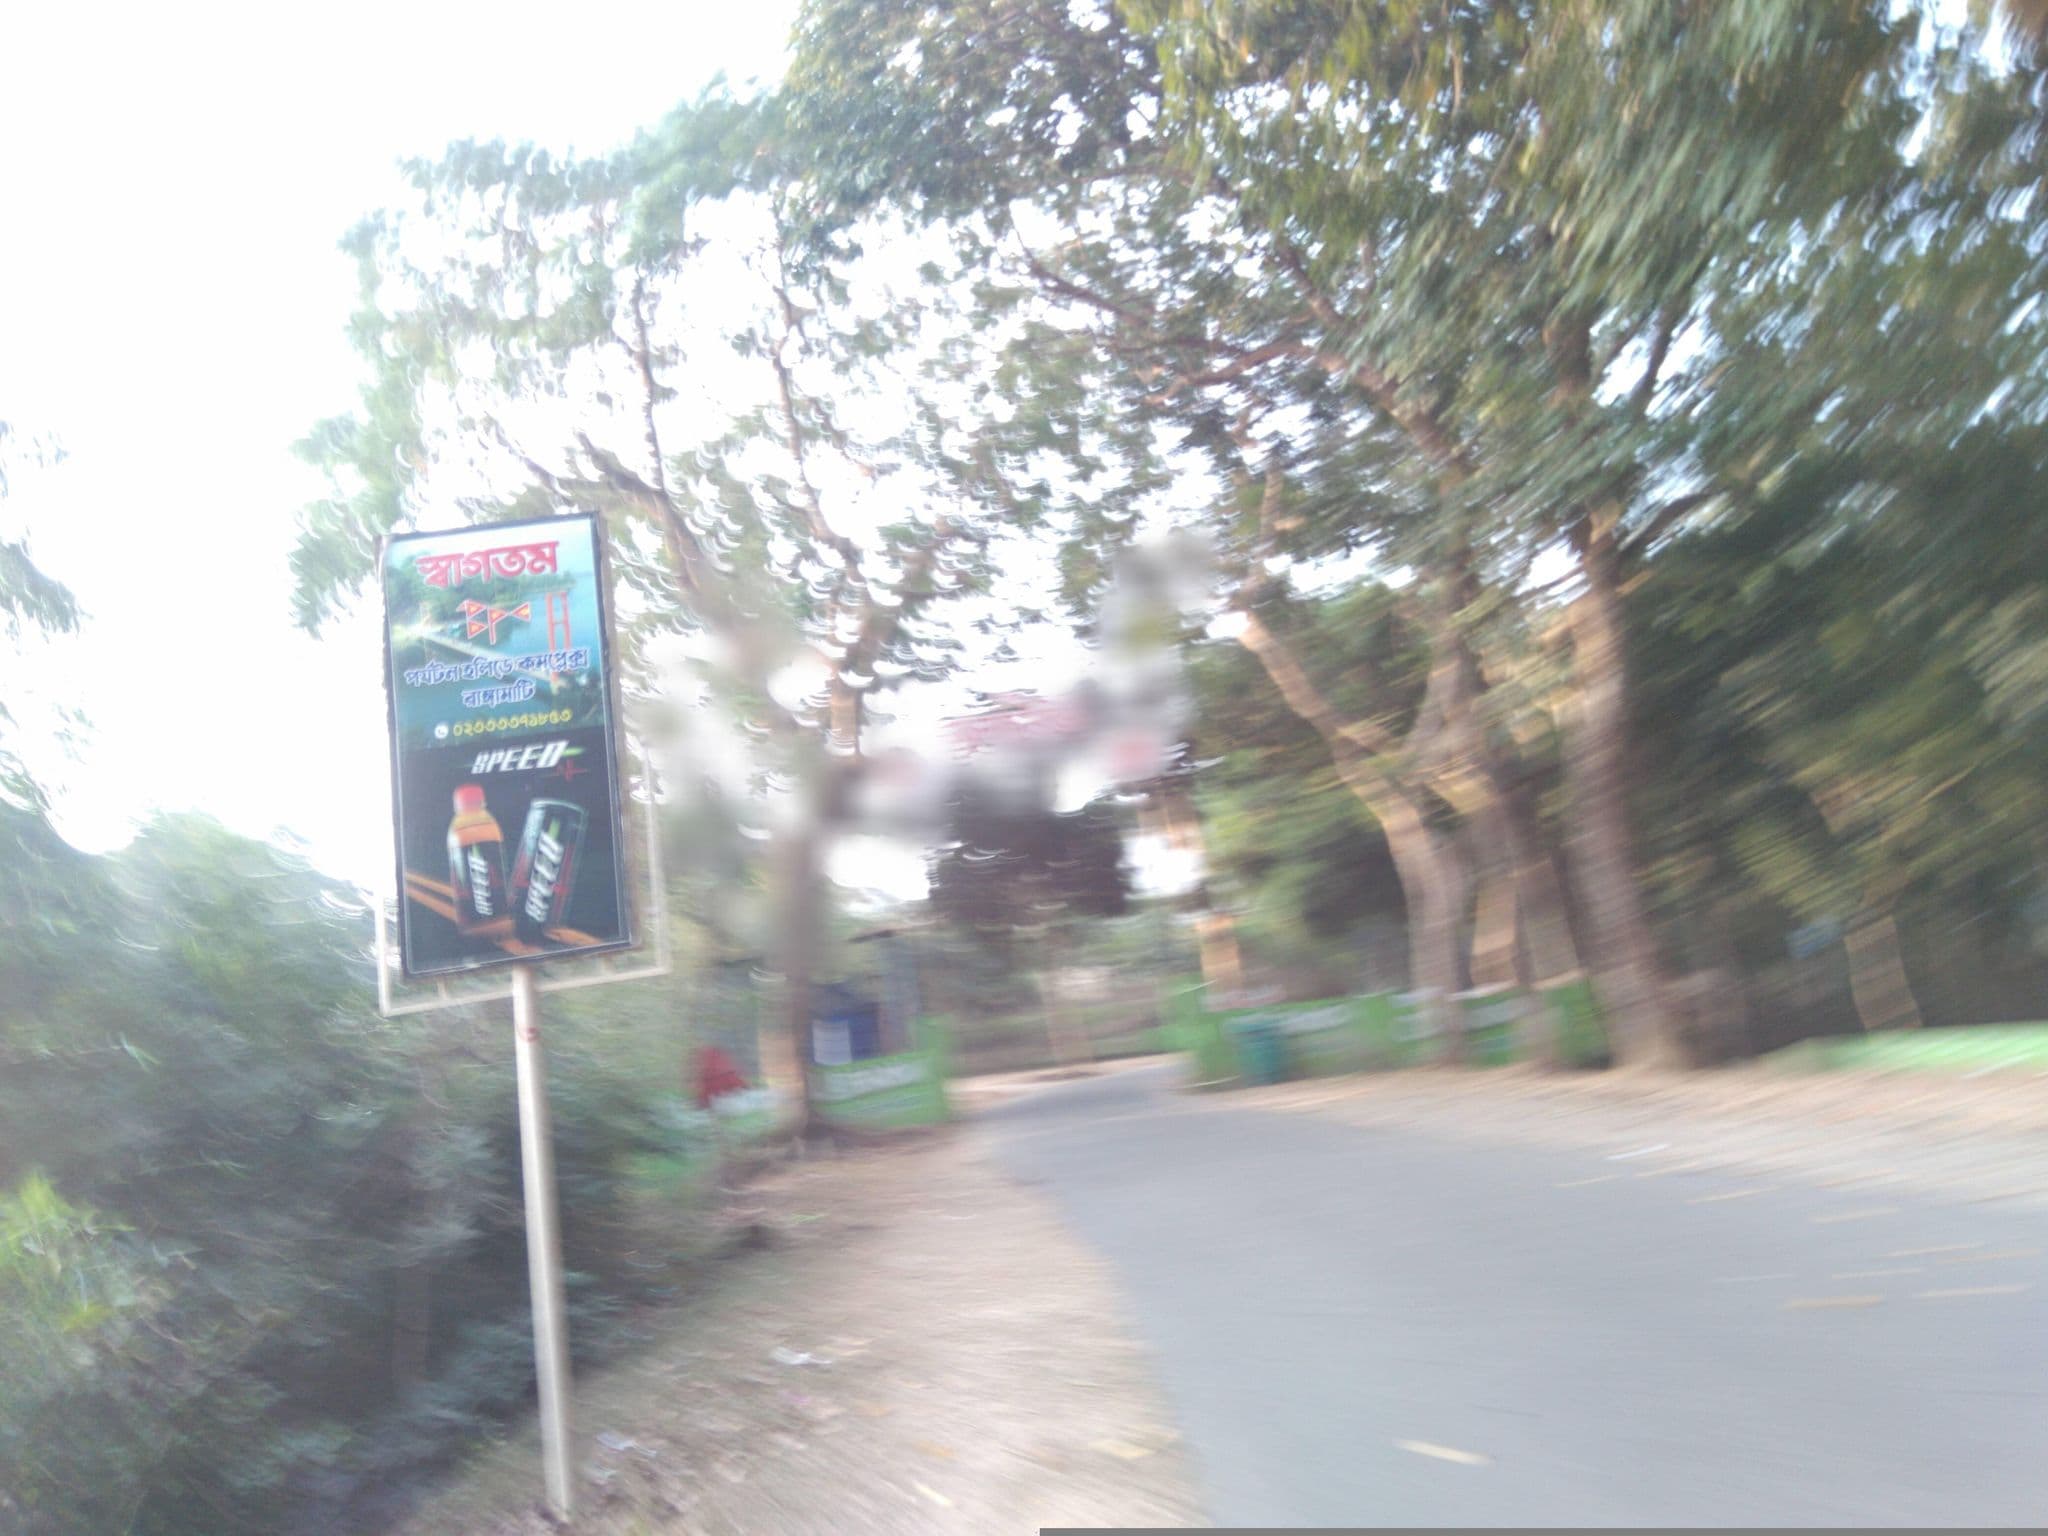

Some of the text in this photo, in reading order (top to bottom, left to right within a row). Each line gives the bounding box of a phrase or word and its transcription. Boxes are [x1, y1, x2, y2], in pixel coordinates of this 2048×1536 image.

[404, 648, 590, 687] পর্যটন হলিডে কমপ্লেক্স
[471, 739, 569, 774] SPEED
